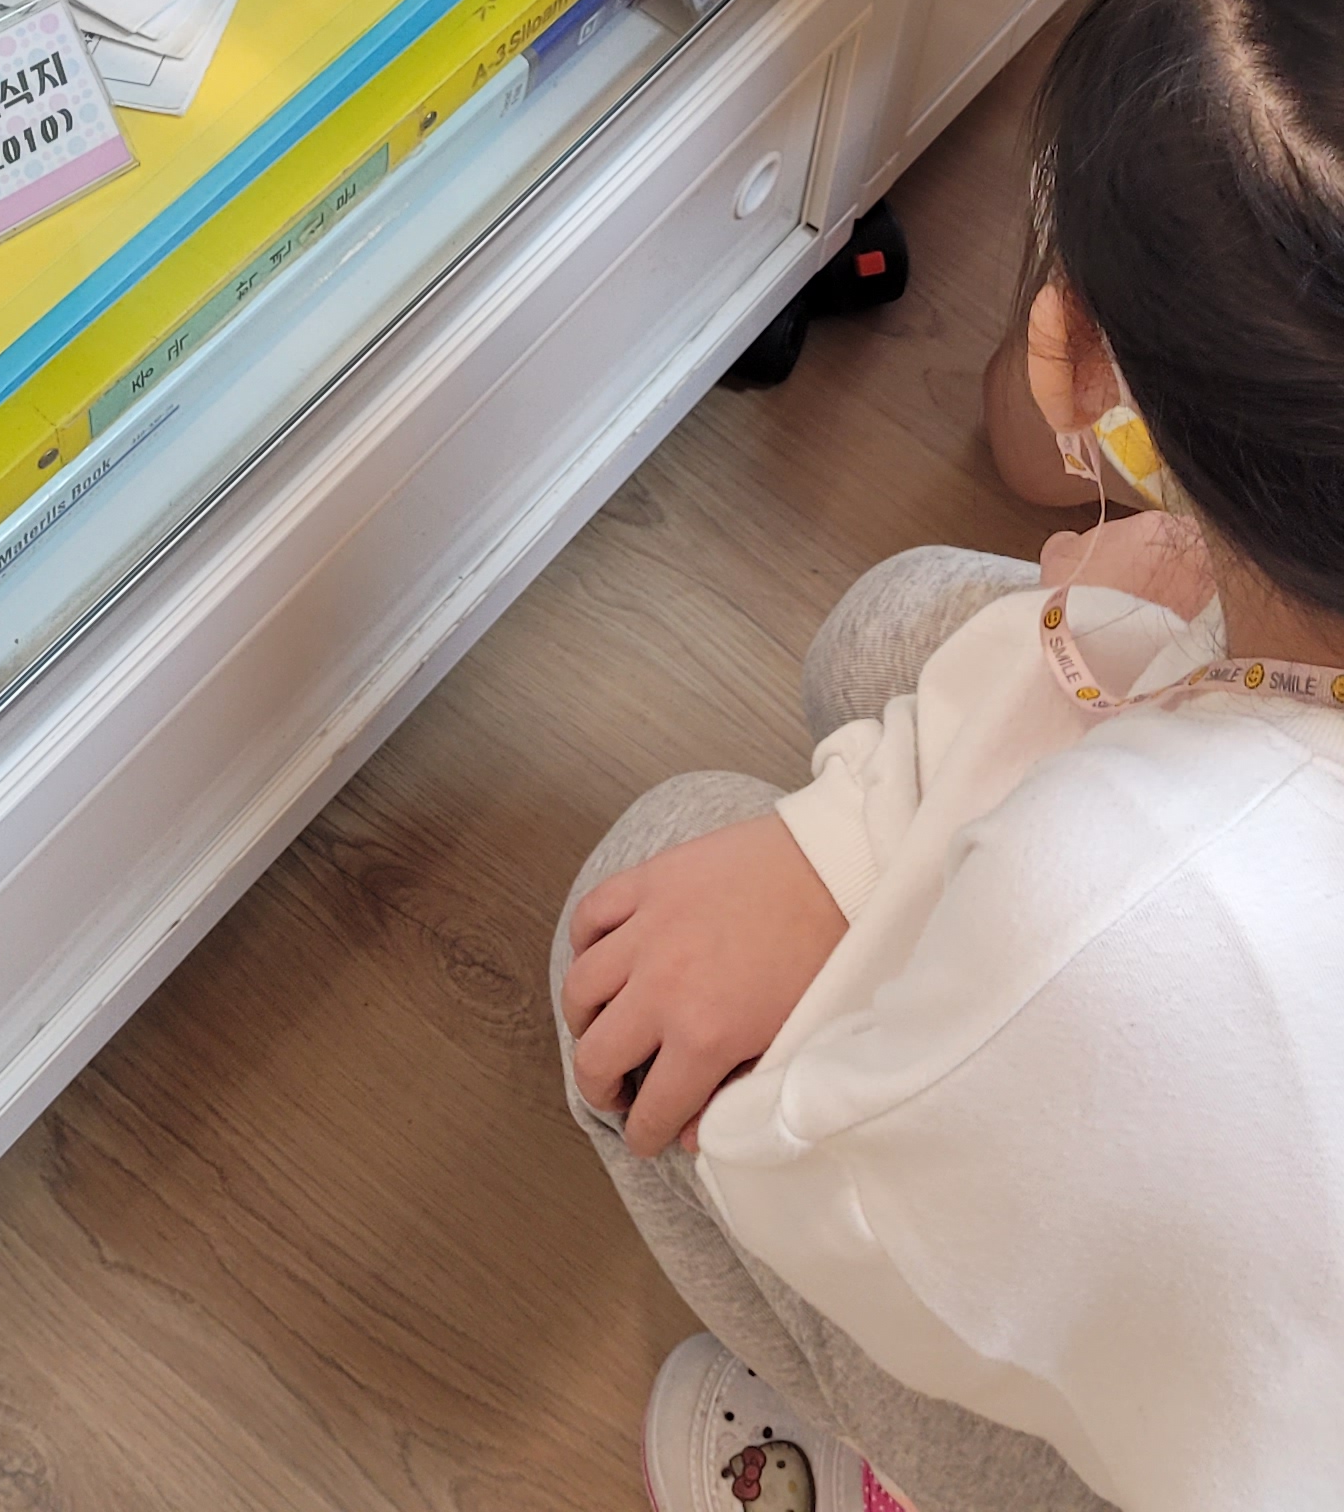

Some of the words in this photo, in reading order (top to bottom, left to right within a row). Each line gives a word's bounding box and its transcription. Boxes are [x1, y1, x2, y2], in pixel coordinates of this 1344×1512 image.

[70, 455, 114, 502] Book
[1048, 635, 1084, 686] SMILE
[1269, 672, 1318, 699] SMILE
